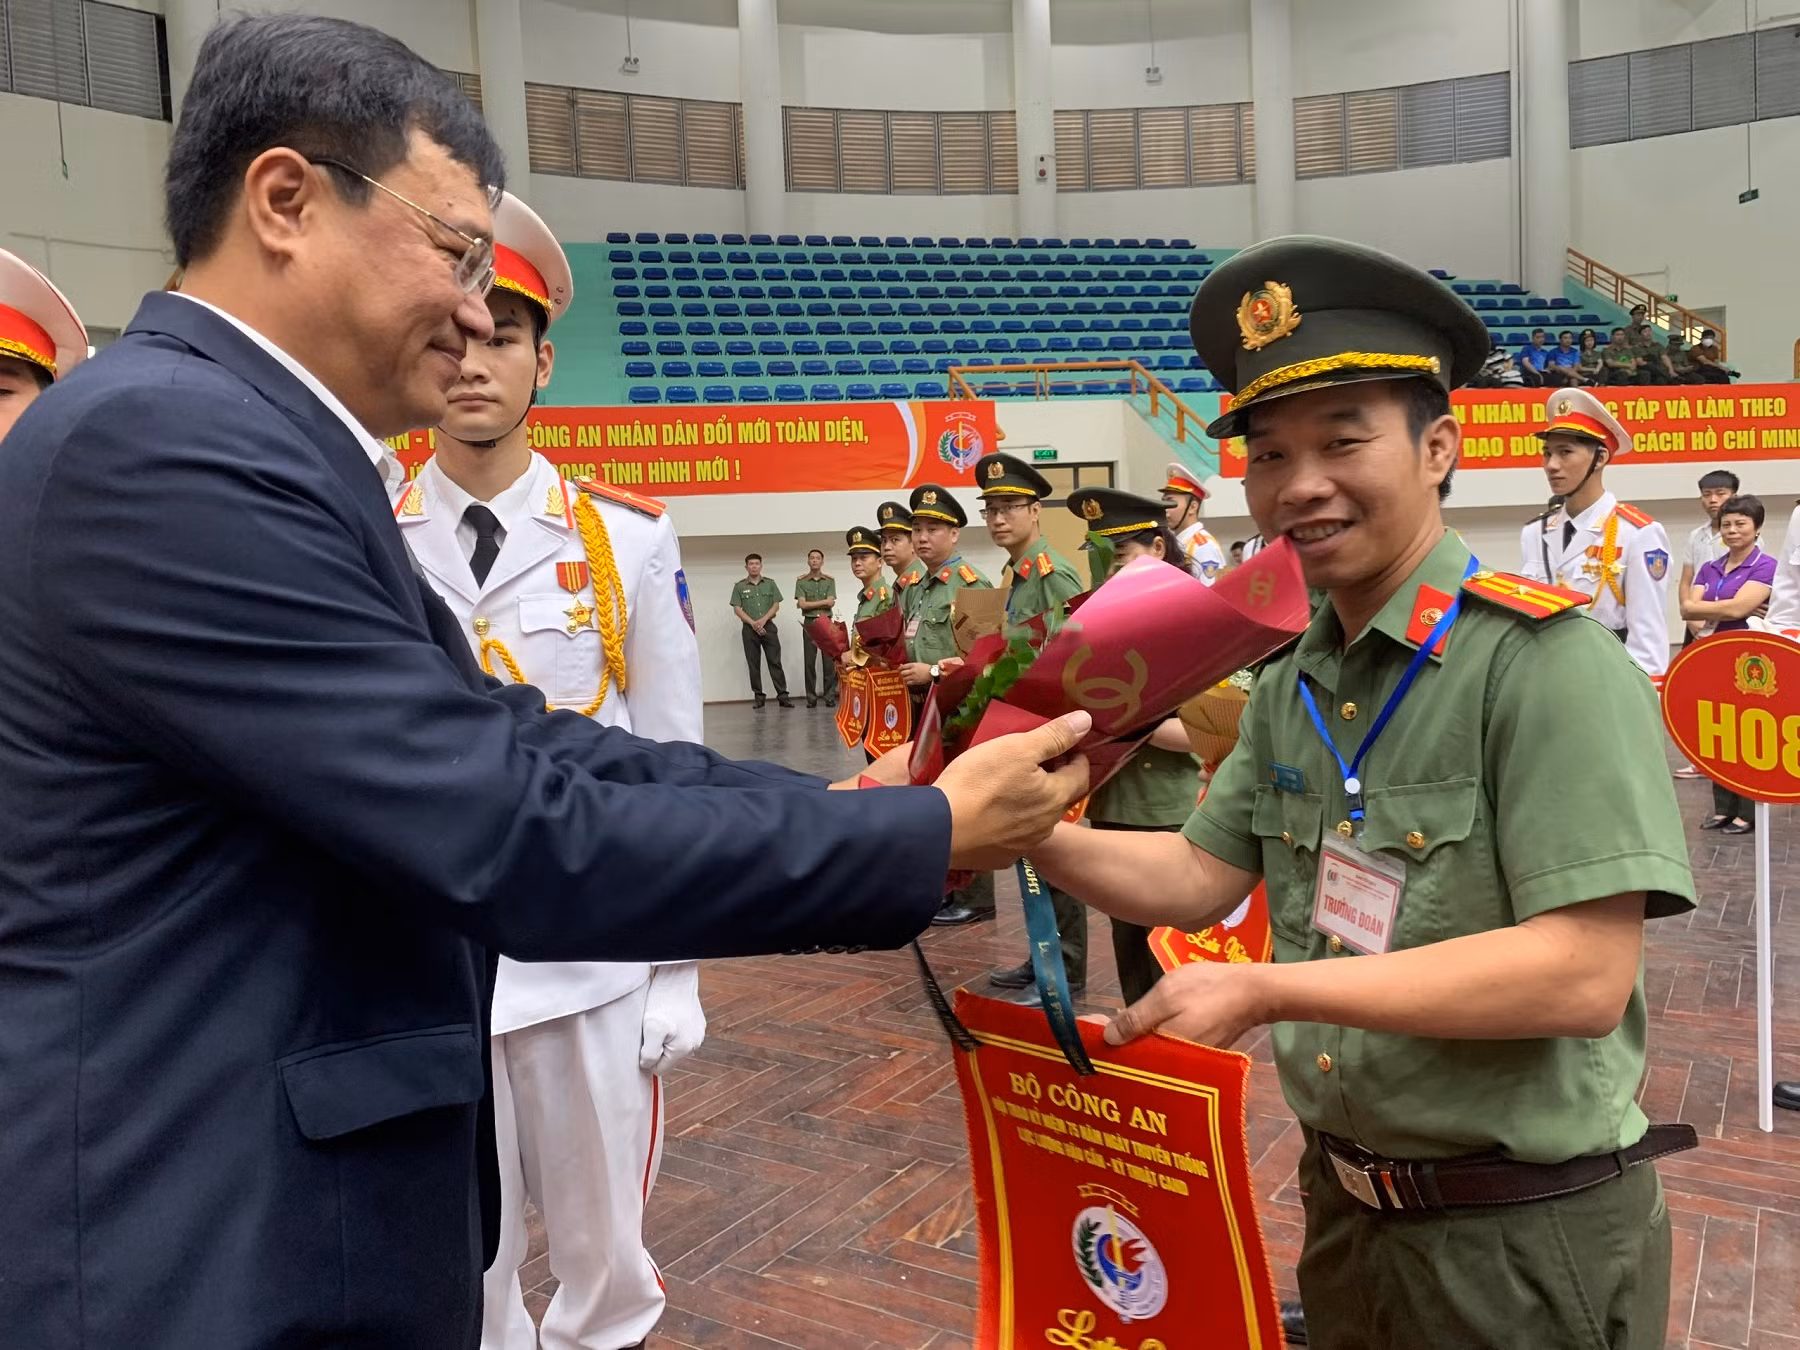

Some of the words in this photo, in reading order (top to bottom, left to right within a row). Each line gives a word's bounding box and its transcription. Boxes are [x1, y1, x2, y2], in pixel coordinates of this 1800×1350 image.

[1472, 400, 1526, 424] NHÂN
[1623, 397, 1661, 424] TẬP
[1665, 396, 1692, 419] VÀ
[1696, 395, 1735, 418] LÀM
[1739, 397, 1787, 417] THEO
[576, 425, 602, 448] AN
[607, 420, 658, 447] NHÂN
[662, 419, 699, 446] DÂN
[703, 414, 733, 445] ĐỔI
[738, 417, 772, 444] MỚI
[776, 416, 821, 443] TOÀN
[825, 418, 870, 447] DIỆN,
[1633, 429, 1685, 452] CÁCH
[1691, 424, 1717, 451] HỒ
[1723, 426, 1756, 450] CHÍ
[1761, 428, 1800, 449] MIN
[1462, 436, 1504, 461] ĐẠO
[601, 458, 643, 485] TÌNH
[648, 457, 691, 484] HÌNH
[696, 456, 730, 482] MỚI
[1008, 1071, 1042, 1104] BỘ
[1048, 1082, 1121, 1124] CÔNG
[1129, 1105, 1168, 1136] AN
